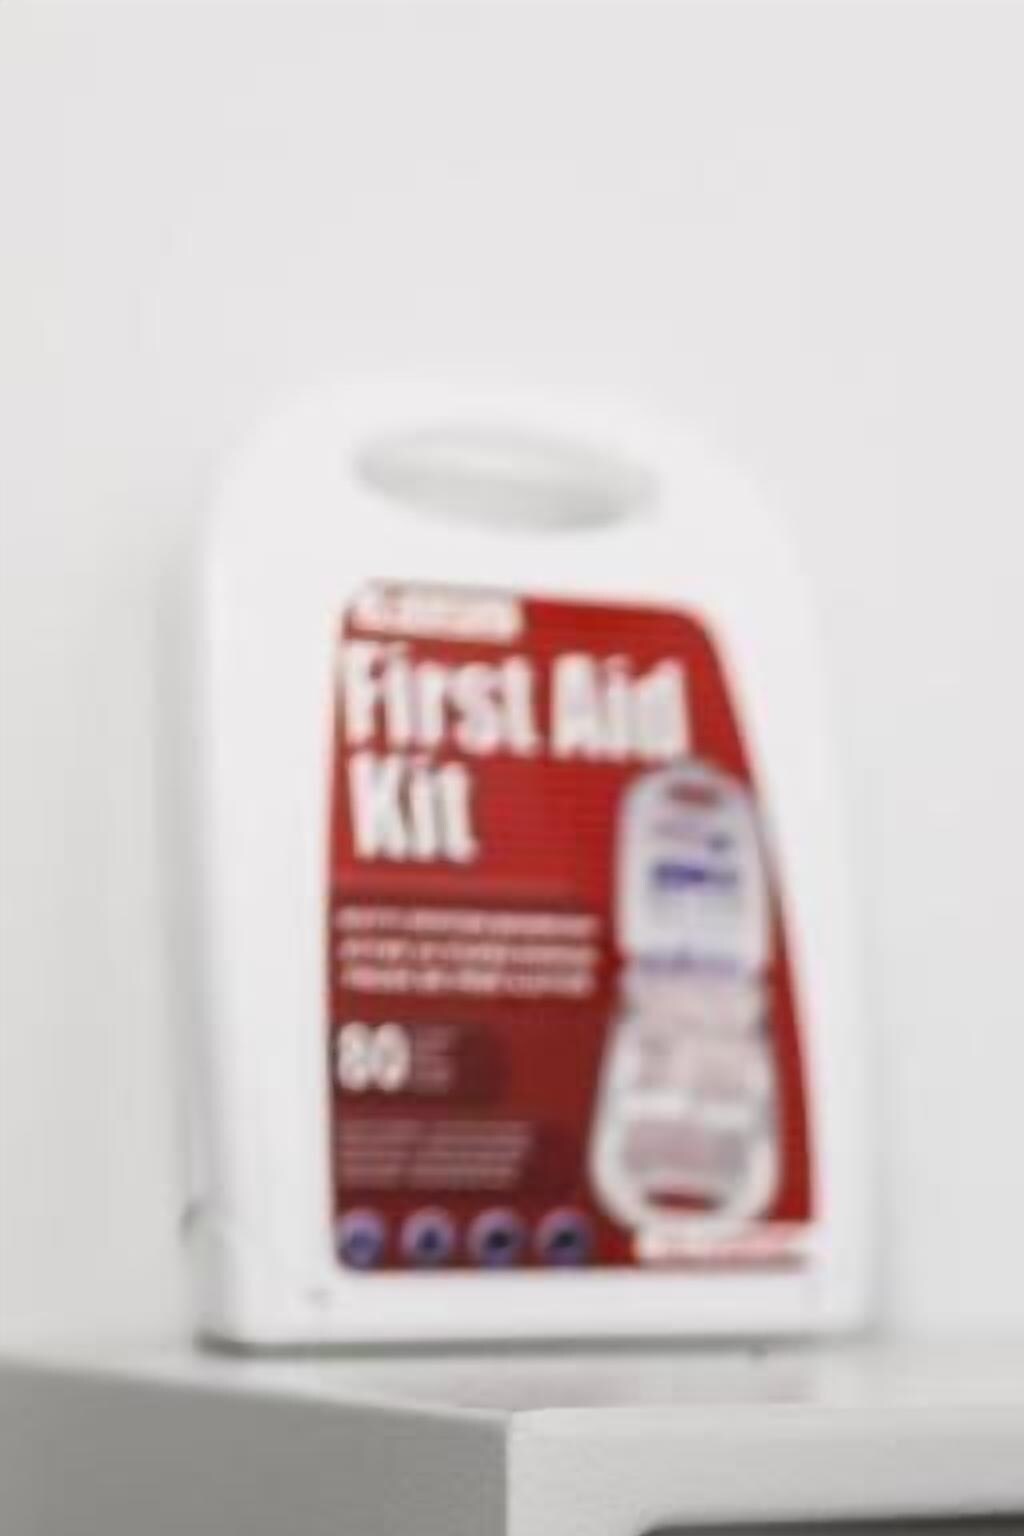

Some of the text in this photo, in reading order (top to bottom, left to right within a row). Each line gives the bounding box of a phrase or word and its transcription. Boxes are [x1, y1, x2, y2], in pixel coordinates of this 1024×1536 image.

[345, 642, 689, 760] First Aid
[349, 750, 478, 862] Kit
